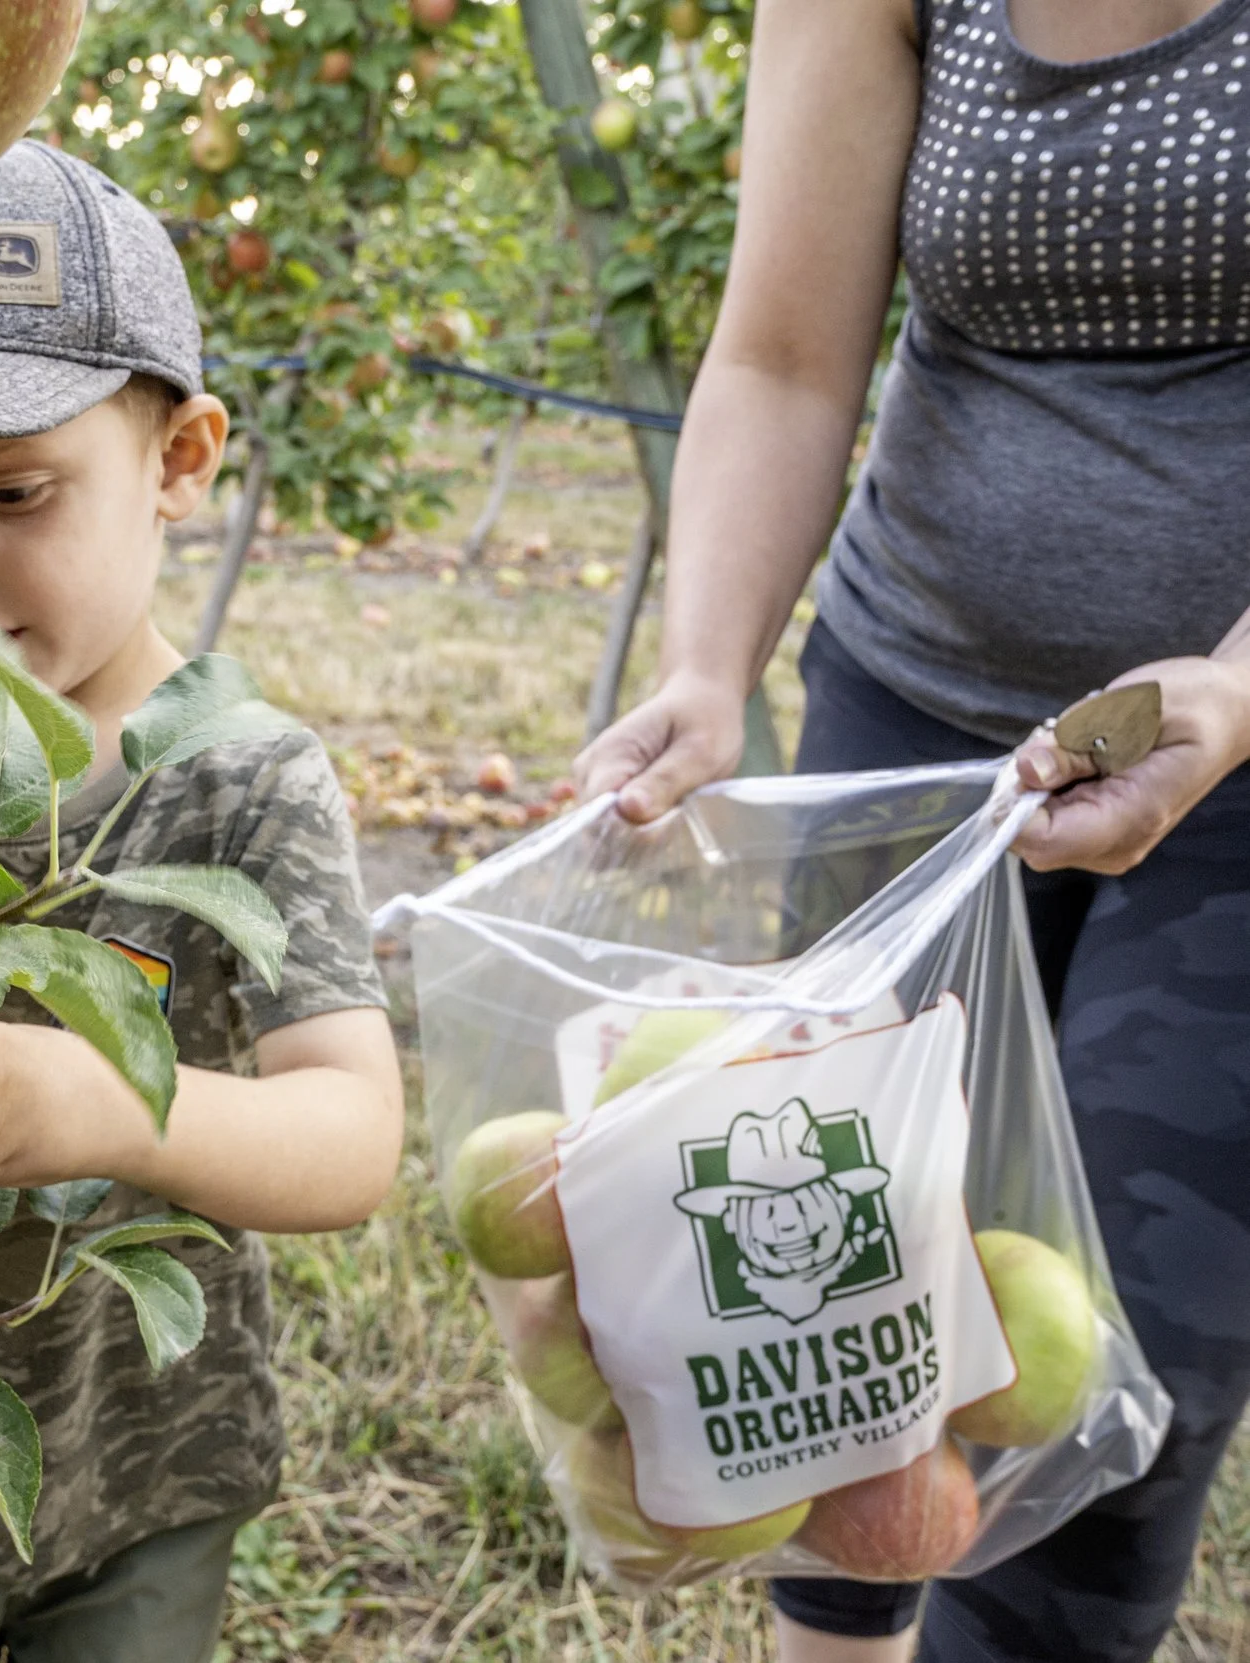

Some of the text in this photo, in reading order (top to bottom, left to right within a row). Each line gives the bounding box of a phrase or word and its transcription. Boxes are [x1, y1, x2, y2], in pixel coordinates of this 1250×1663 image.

[10, 283, 43, 291] DEERE
[685, 1290, 933, 1410] DAVISON
[704, 1343, 939, 1457] ORCHARDS
[717, 1436, 842, 1482] COUNTRY
